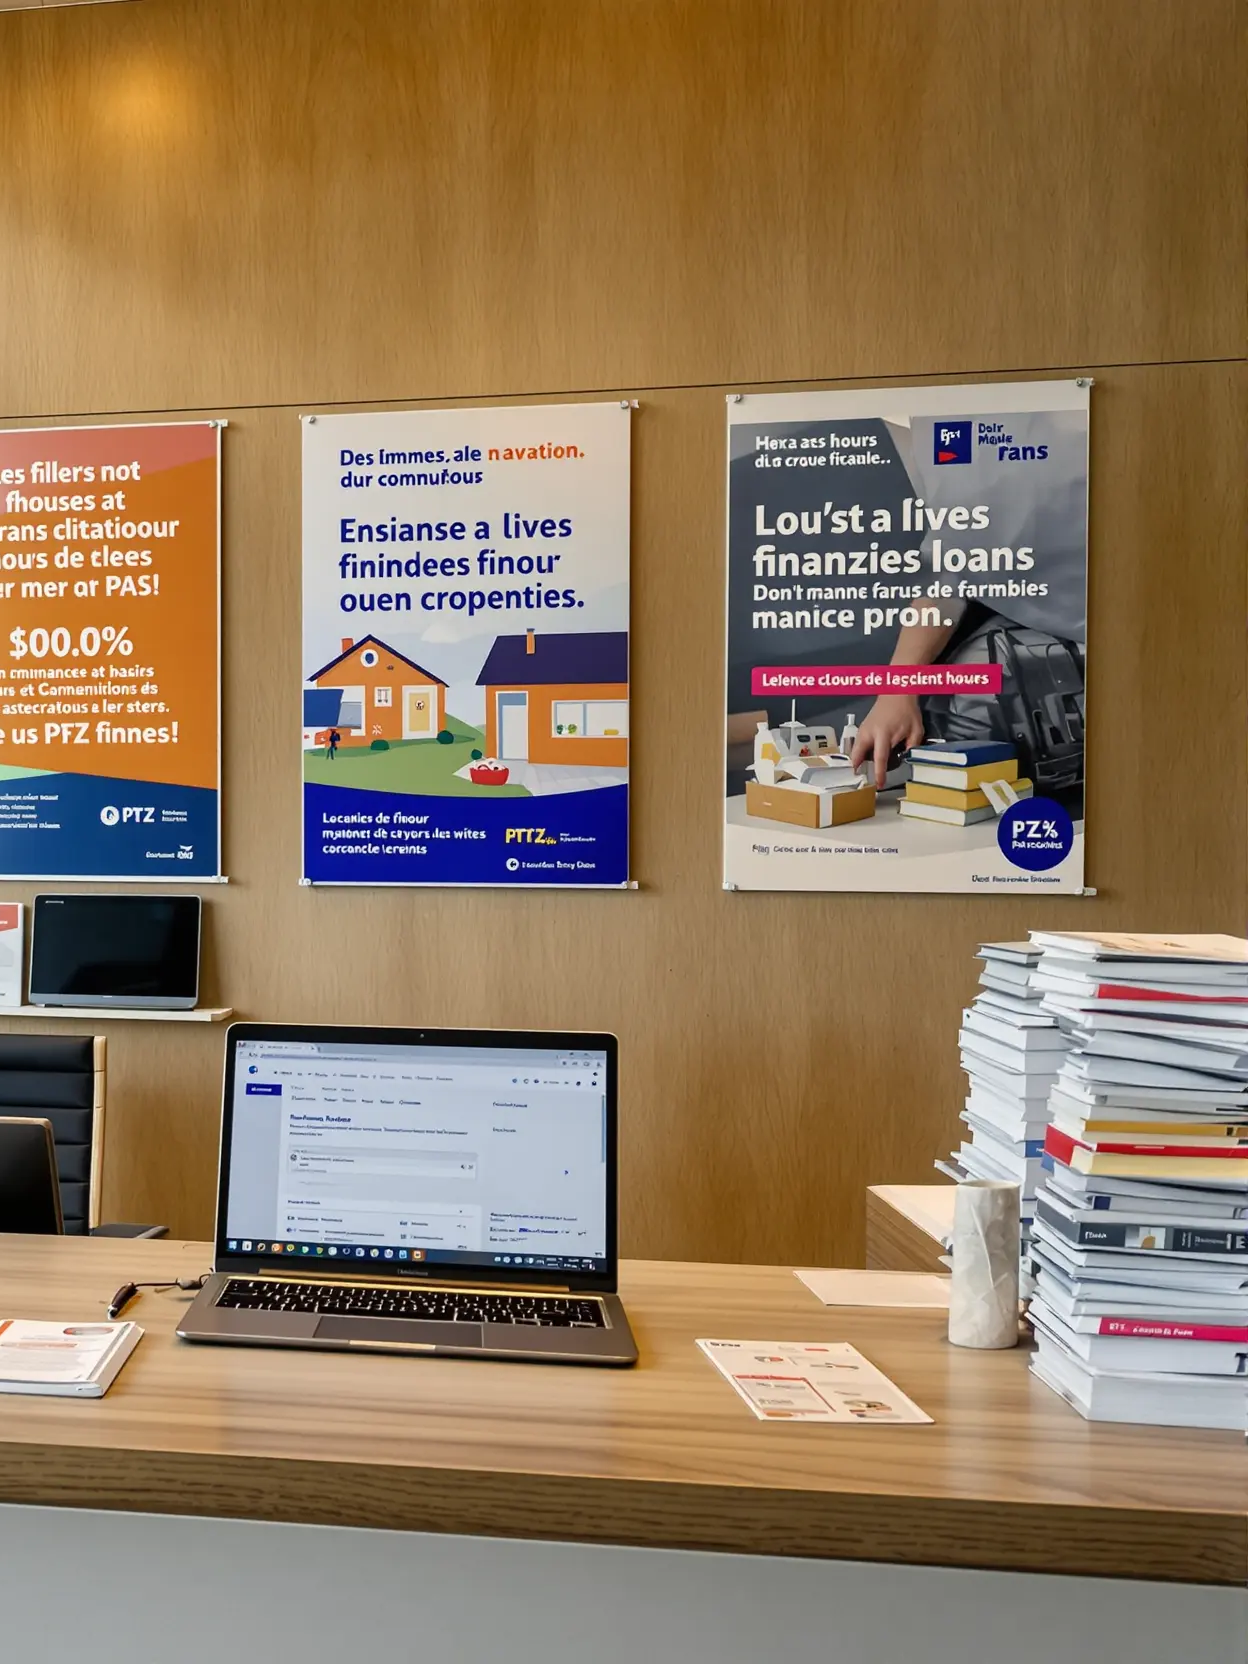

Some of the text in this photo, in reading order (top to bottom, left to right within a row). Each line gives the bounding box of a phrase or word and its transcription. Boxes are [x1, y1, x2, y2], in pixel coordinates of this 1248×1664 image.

[830, 433, 877, 448] hours
[340, 449, 374, 466] Des
[453, 445, 482, 462] ale
[31, 460, 96, 483] fillers
[101, 460, 141, 482] not
[340, 471, 373, 488] dur
[5, 490, 126, 513] fhouses at
[871, 508, 892, 533] a
[902, 498, 990, 532] lives
[340, 512, 572, 544] Ensianse a lives
[54, 546, 84, 569] de
[339, 552, 470, 579] finindees
[752, 539, 1035, 577] finanzies loans
[21, 579, 68, 599] mer
[105, 573, 159, 597] PAS!
[753, 584, 803, 601] Don't
[872, 581, 922, 600] farus
[926, 581, 952, 598] de
[340, 583, 585, 617] ouen cropenties.
[864, 606, 953, 635] pron.
[9, 626, 134, 660] $00.0%
[20, 684, 35, 697] et
[865, 672, 882, 686] de
[11, 728, 38, 744] us
[44, 722, 90, 744] PFZ
[96, 721, 179, 744] finnes!
[122, 807, 155, 823] PTZ
